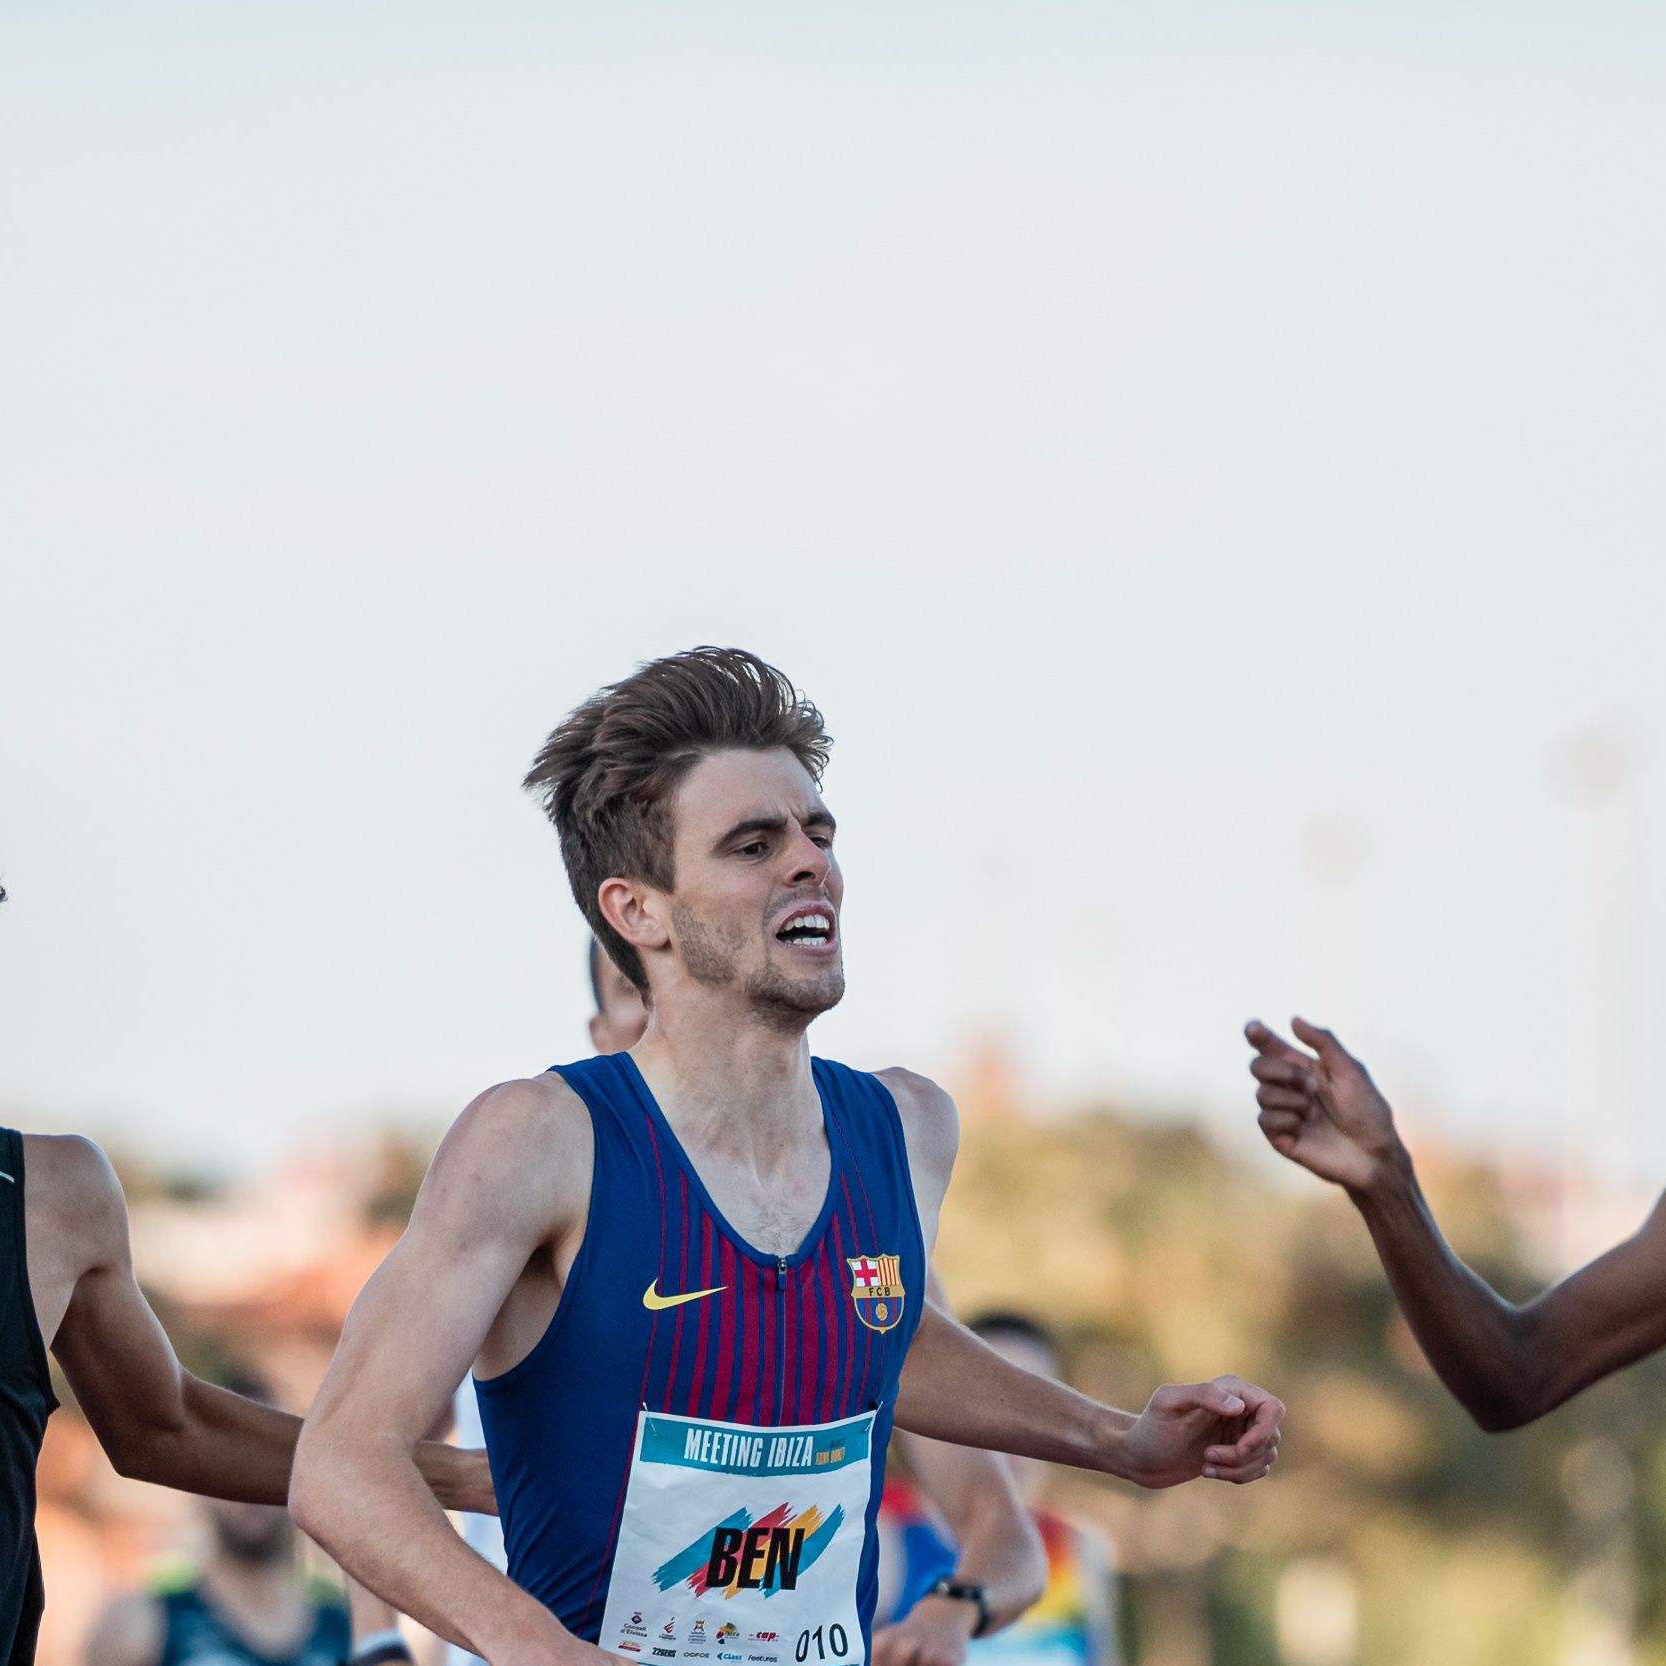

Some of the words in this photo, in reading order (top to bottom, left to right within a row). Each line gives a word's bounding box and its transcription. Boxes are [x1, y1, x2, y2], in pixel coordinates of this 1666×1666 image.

[684, 1428, 764, 1468] MEETING
[767, 1435, 814, 1467] IBIZA
[705, 1527, 806, 1590] BEN
[795, 1623, 848, 1662] 010
